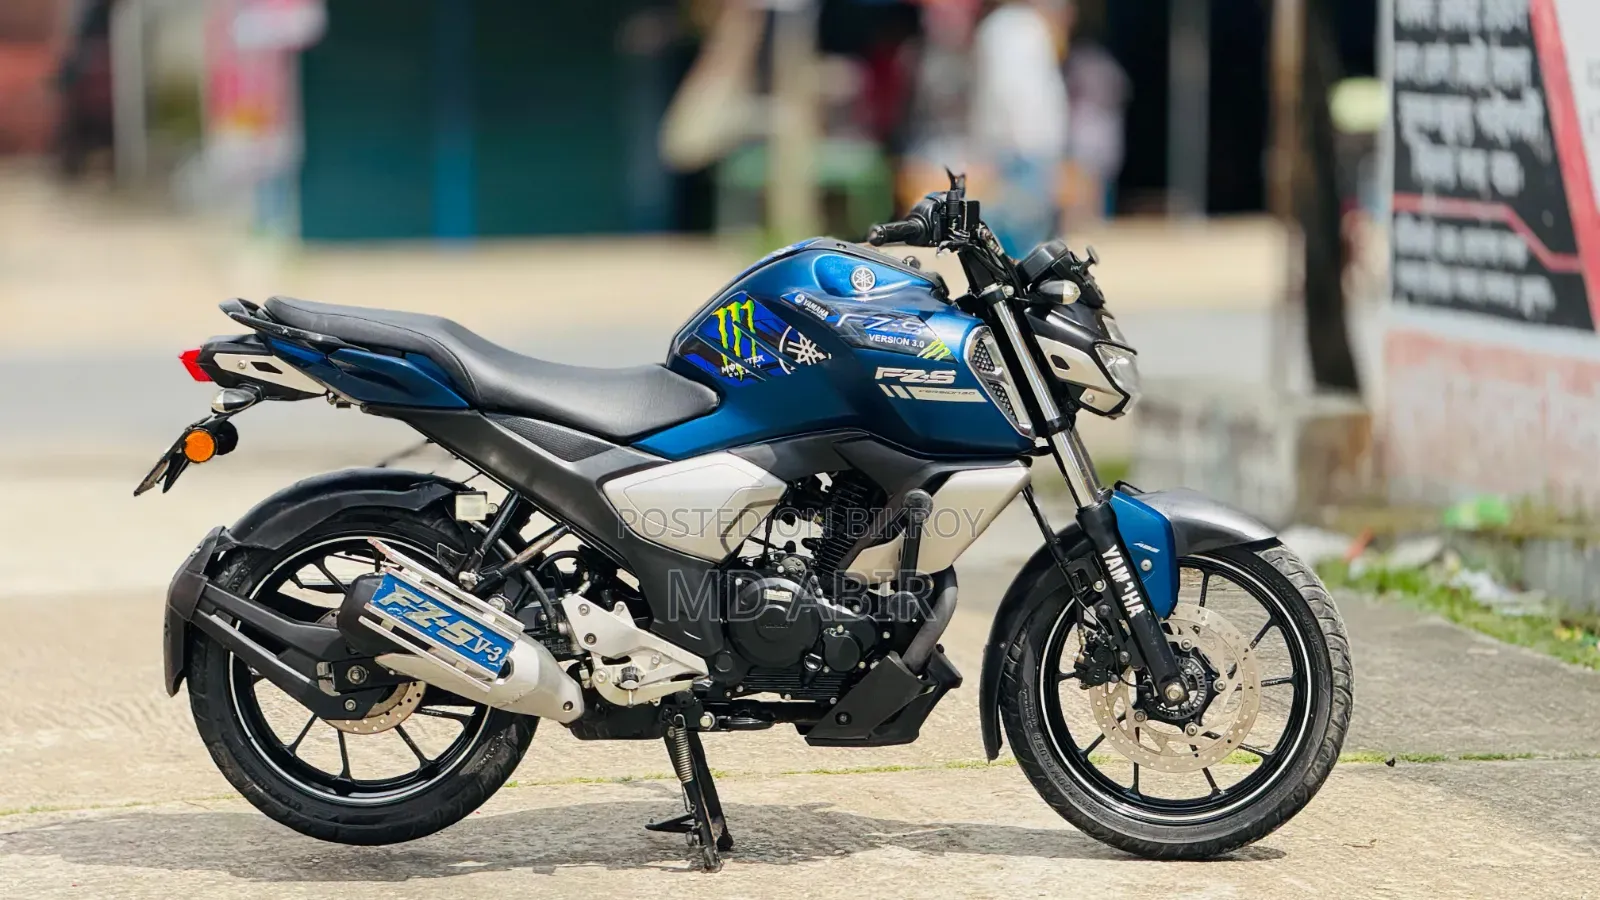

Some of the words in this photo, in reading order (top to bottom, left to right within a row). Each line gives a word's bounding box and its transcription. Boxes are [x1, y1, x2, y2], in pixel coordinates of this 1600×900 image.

[803, 299, 829, 317] YAMAHA
[869, 333, 909, 346] VERSION
[911, 338, 925, 348] 3.0
[875, 367, 957, 384] FZ-S
